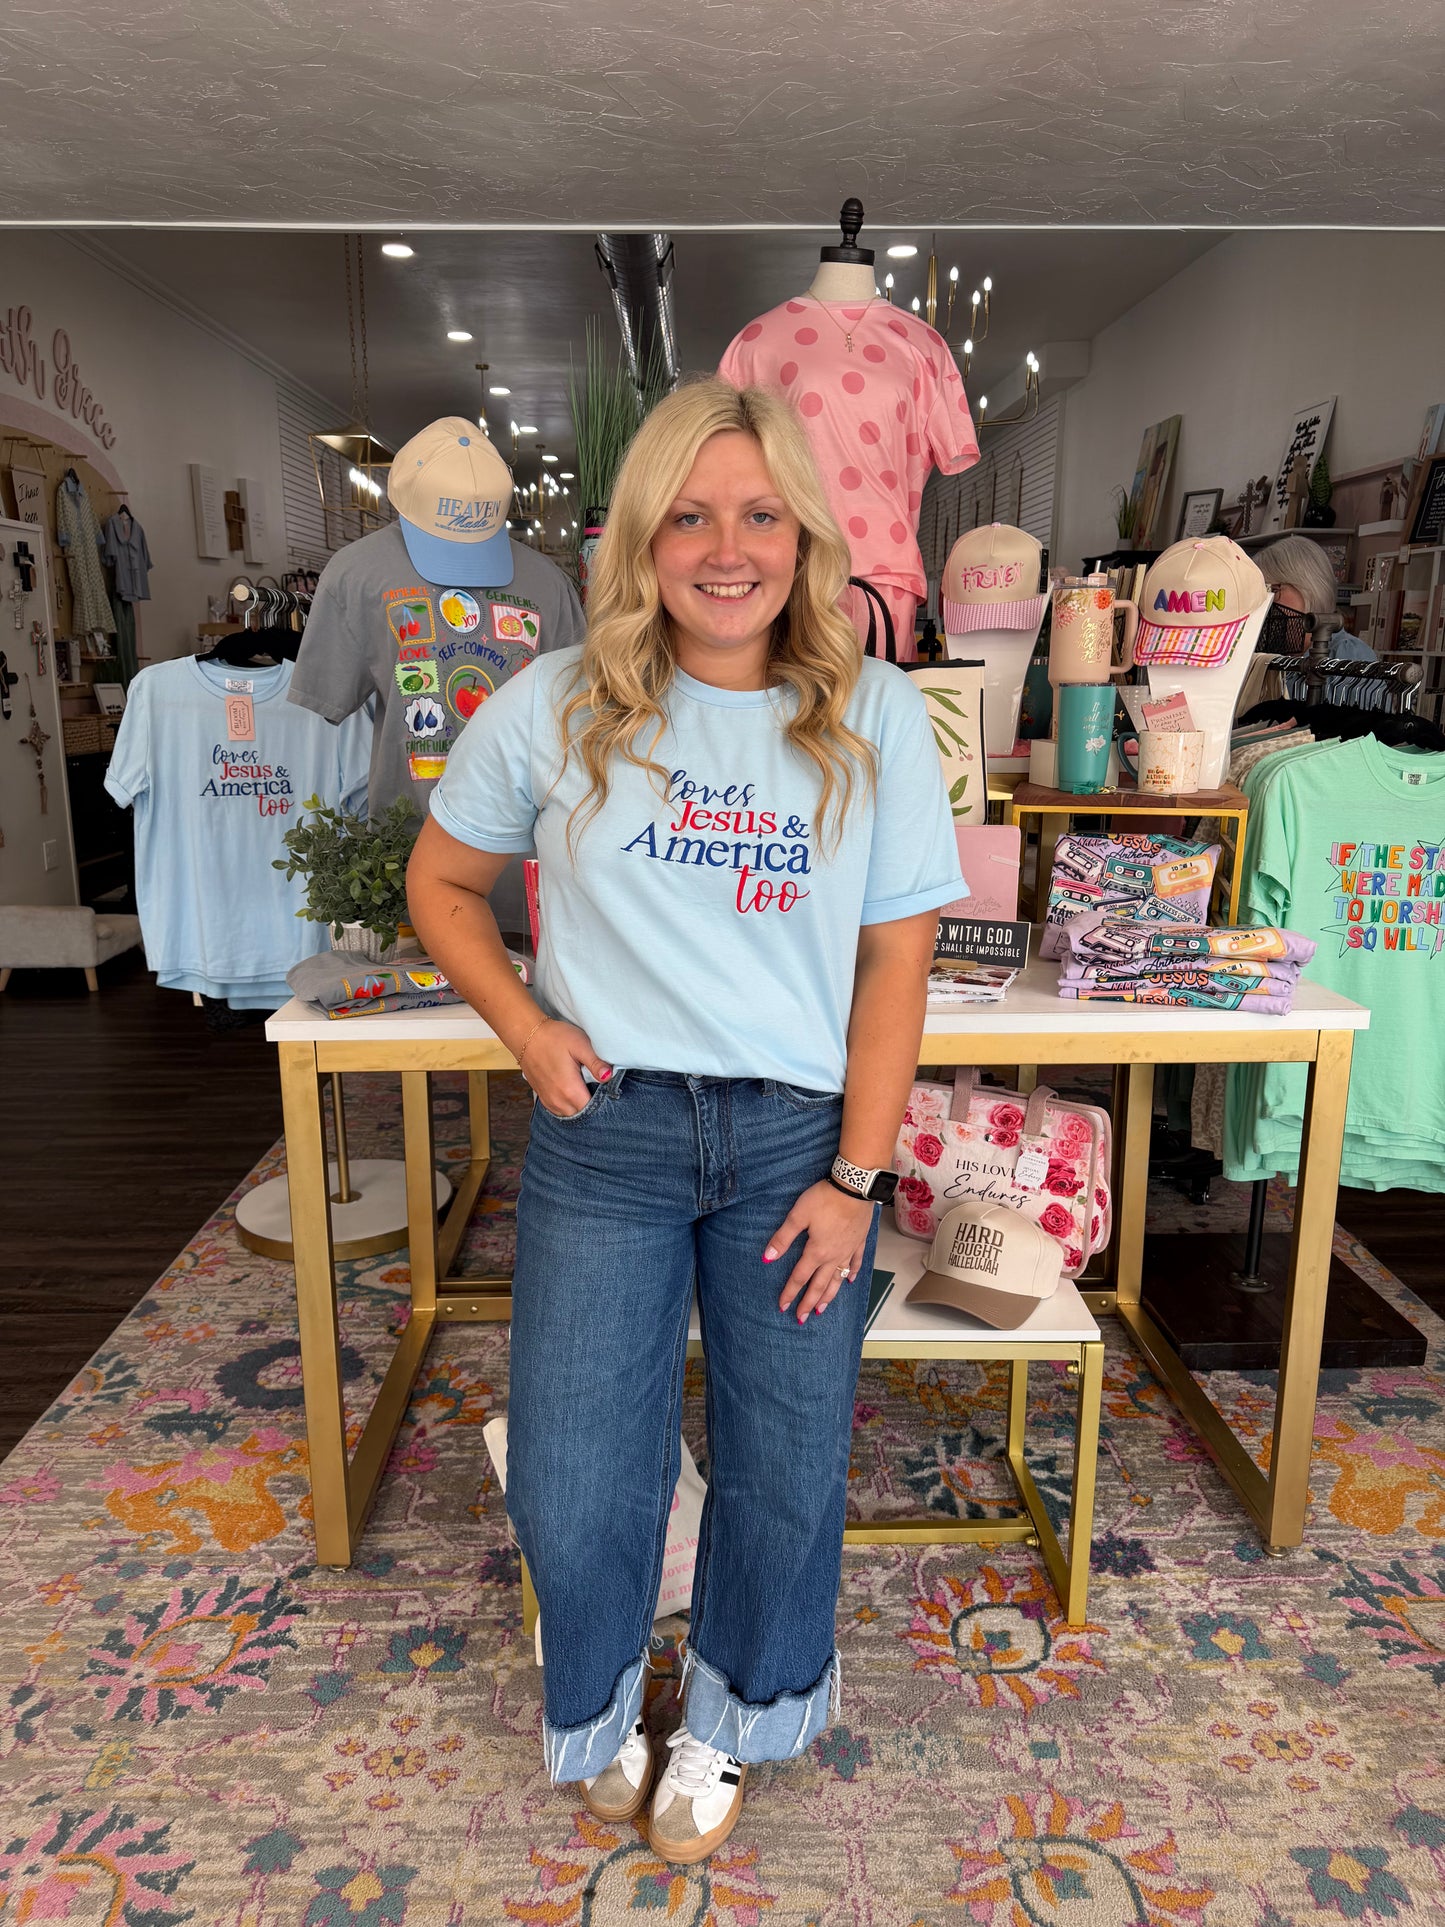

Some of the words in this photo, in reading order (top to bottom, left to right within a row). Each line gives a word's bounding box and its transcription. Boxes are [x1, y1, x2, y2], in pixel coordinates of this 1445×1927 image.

[437, 497, 501, 518] HEAVEN
[448, 515, 490, 528] Made
[1154, 588, 1226, 613] AMEN
[462, 614, 478, 628] JOY
[399, 646, 432, 661] LOVE
[439, 642, 509, 671] SELF-CONTROL
[212, 744, 259, 765] loves
[220, 761, 273, 780] Jesus
[275, 766, 289, 778] &
[199, 777, 293, 797] America
[669, 769, 756, 807] loves
[258, 793, 295, 817] too
[670, 800, 778, 835] Jesus
[782, 815, 810, 839] &
[620, 821, 812, 875] America
[1112, 834, 1162, 855] JESUS
[1331, 842, 1357, 866] IF
[1360, 843, 1405, 869] THE
[1409, 847, 1445, 870] STA
[734, 864, 811, 914] too
[1341, 870, 1402, 896] WERE
[1407, 873, 1445, 898] MAD
[1334, 896, 1364, 922] TO
[948, 924, 981, 943] WITH
[986, 927, 1013, 945] GOD
[1346, 925, 1378, 950] SO
[1384, 927, 1430, 951] WILL
[1435, 928, 1444, 952] I
[941, 942, 963, 953] SHALL
[965, 944, 974, 954] BE
[976, 945, 1021, 958] IMPOSSIBLE
[433, 973, 447, 985] JO
[1149, 972, 1209, 986] JESUS
[956, 1158, 980, 1175] HIS
[943, 1173, 1031, 1209] Endures
[955, 1222, 1005, 1248] HARD
[951, 1240, 1003, 1261] FOUGHT
[948, 1253, 999, 1277] HALLELUJAH
